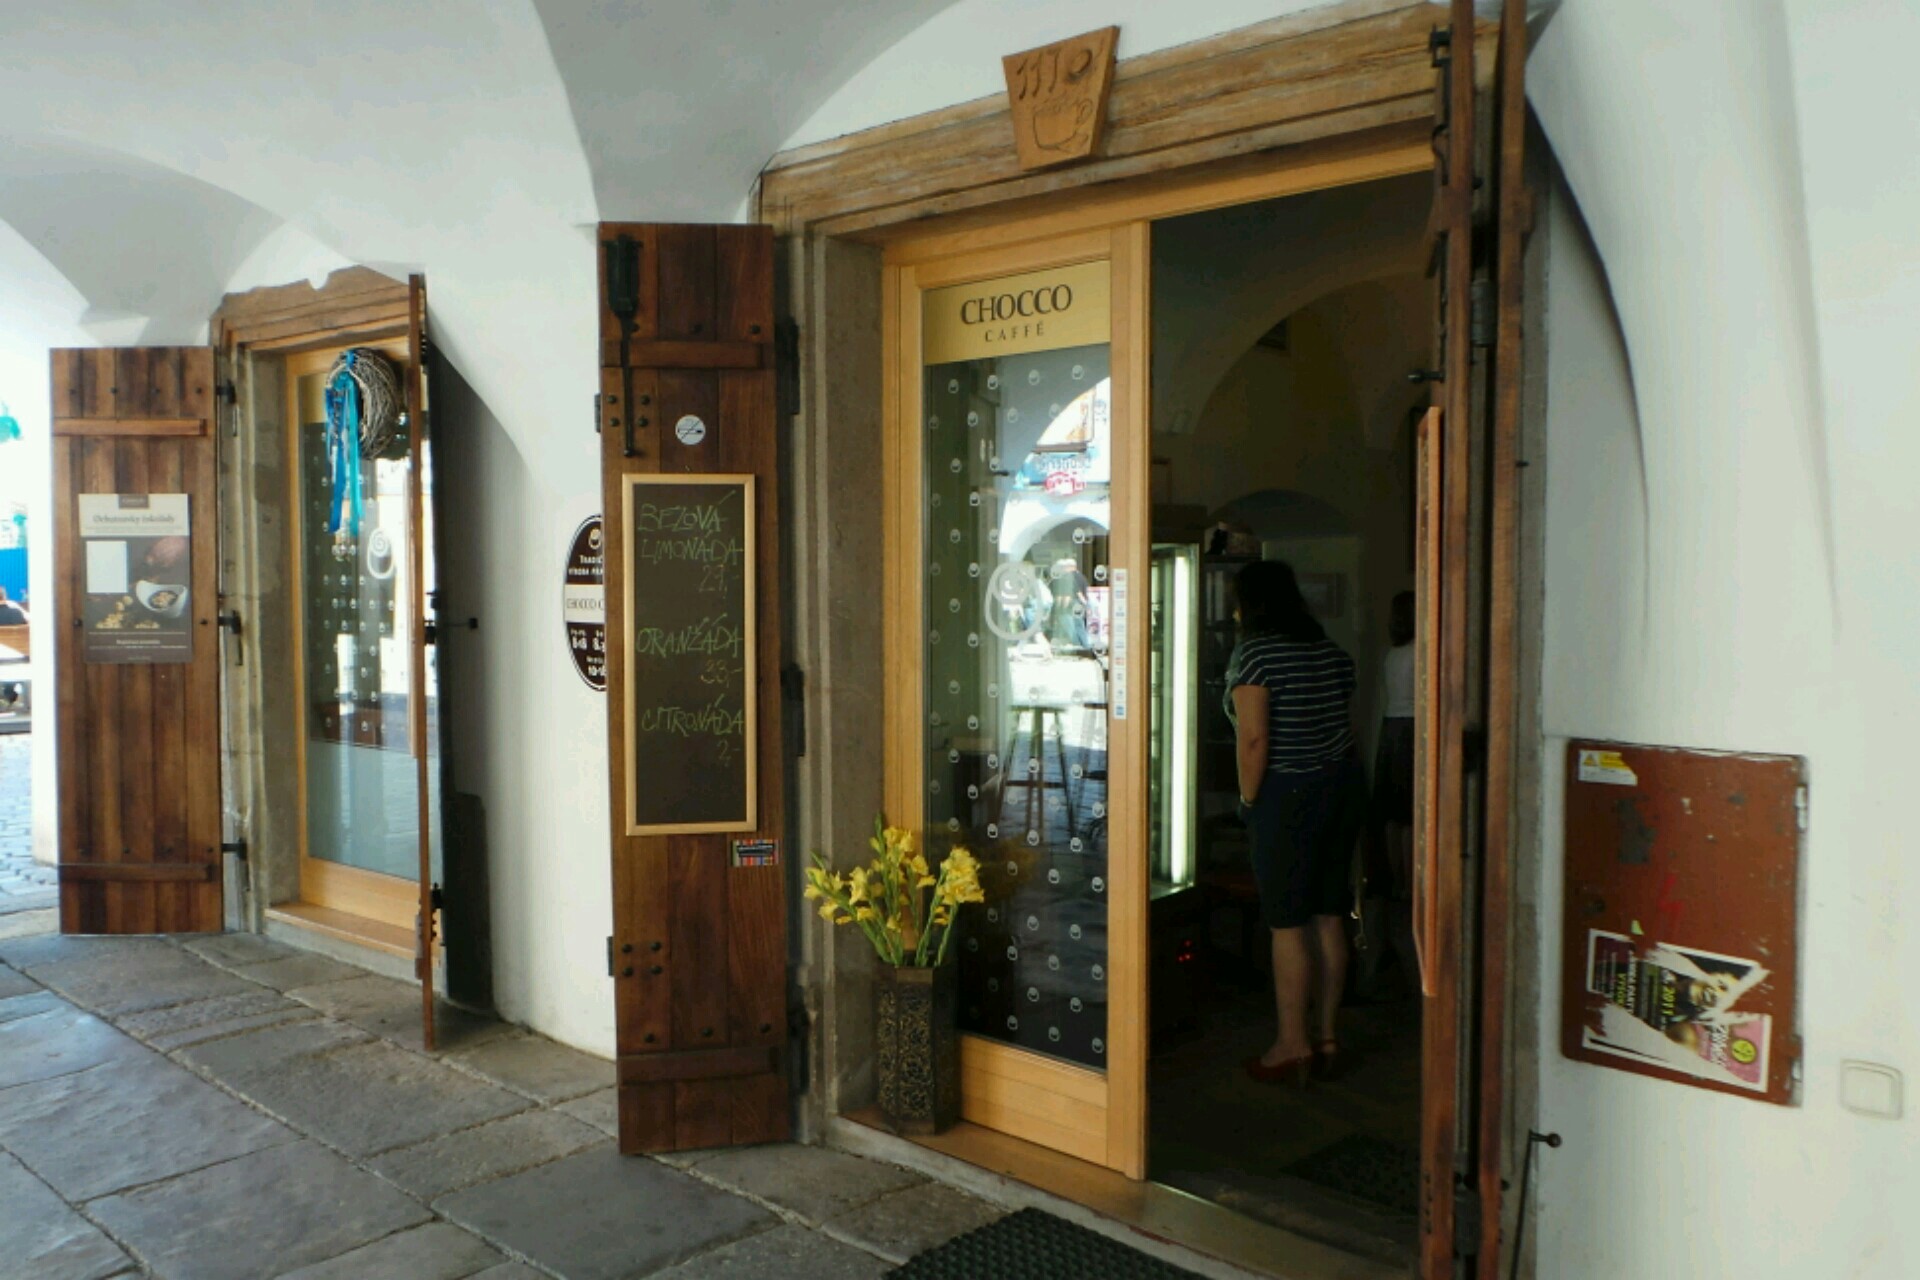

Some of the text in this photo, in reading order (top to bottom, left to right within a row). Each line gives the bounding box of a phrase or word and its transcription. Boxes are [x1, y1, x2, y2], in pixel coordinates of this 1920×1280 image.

[961, 284, 1072, 325] CHOCCO
[641, 529, 744, 565] LIMONÁDA
[1661, 984, 1675, 1016] 2011
